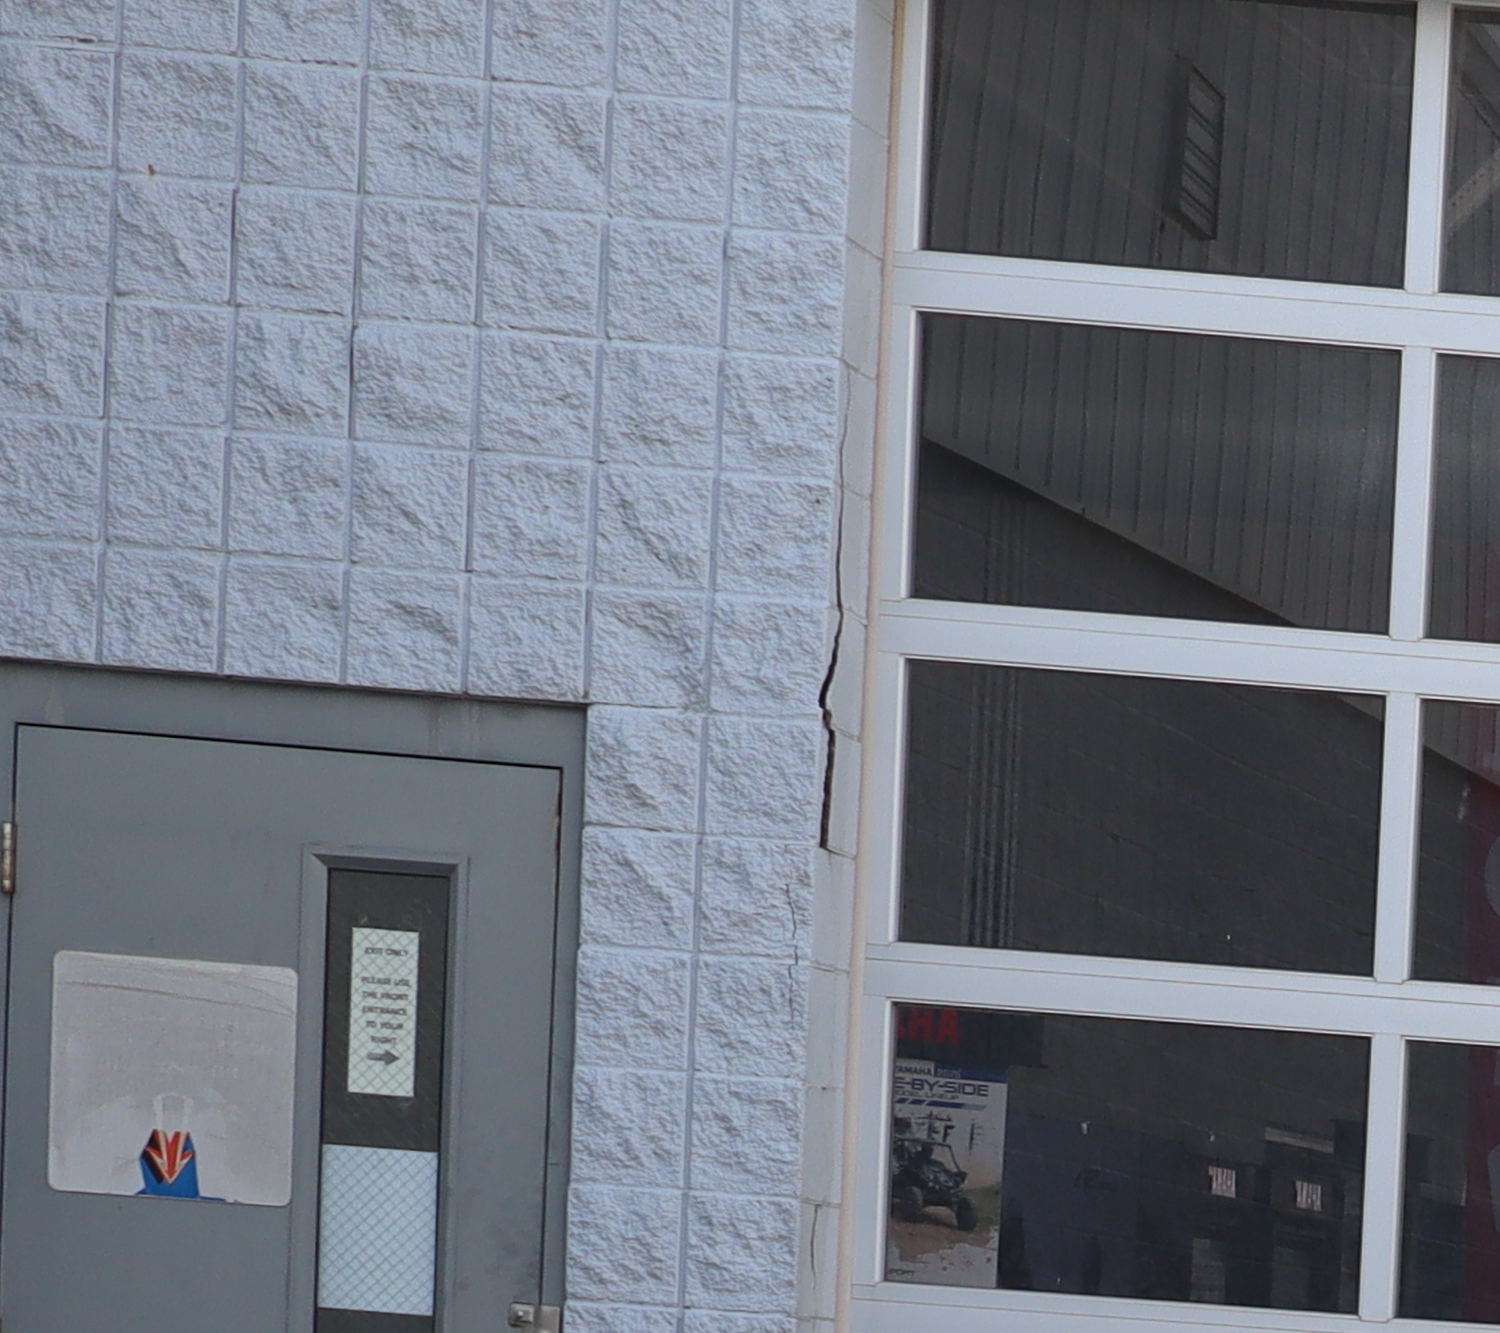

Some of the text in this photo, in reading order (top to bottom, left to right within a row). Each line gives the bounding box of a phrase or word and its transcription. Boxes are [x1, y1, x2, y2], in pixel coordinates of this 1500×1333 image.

[365, 947, 408, 957] EXIT ONLY
[361, 976, 410, 987] PLEASE USE
[362, 991, 409, 1001] THE FRONT
[362, 1005, 407, 1016] ENTRANCE
[366, 1020, 403, 1030] TO YOUR
[370, 1036, 397, 1044] RIGHT
[897, 1065, 933, 1077] AMAHA
